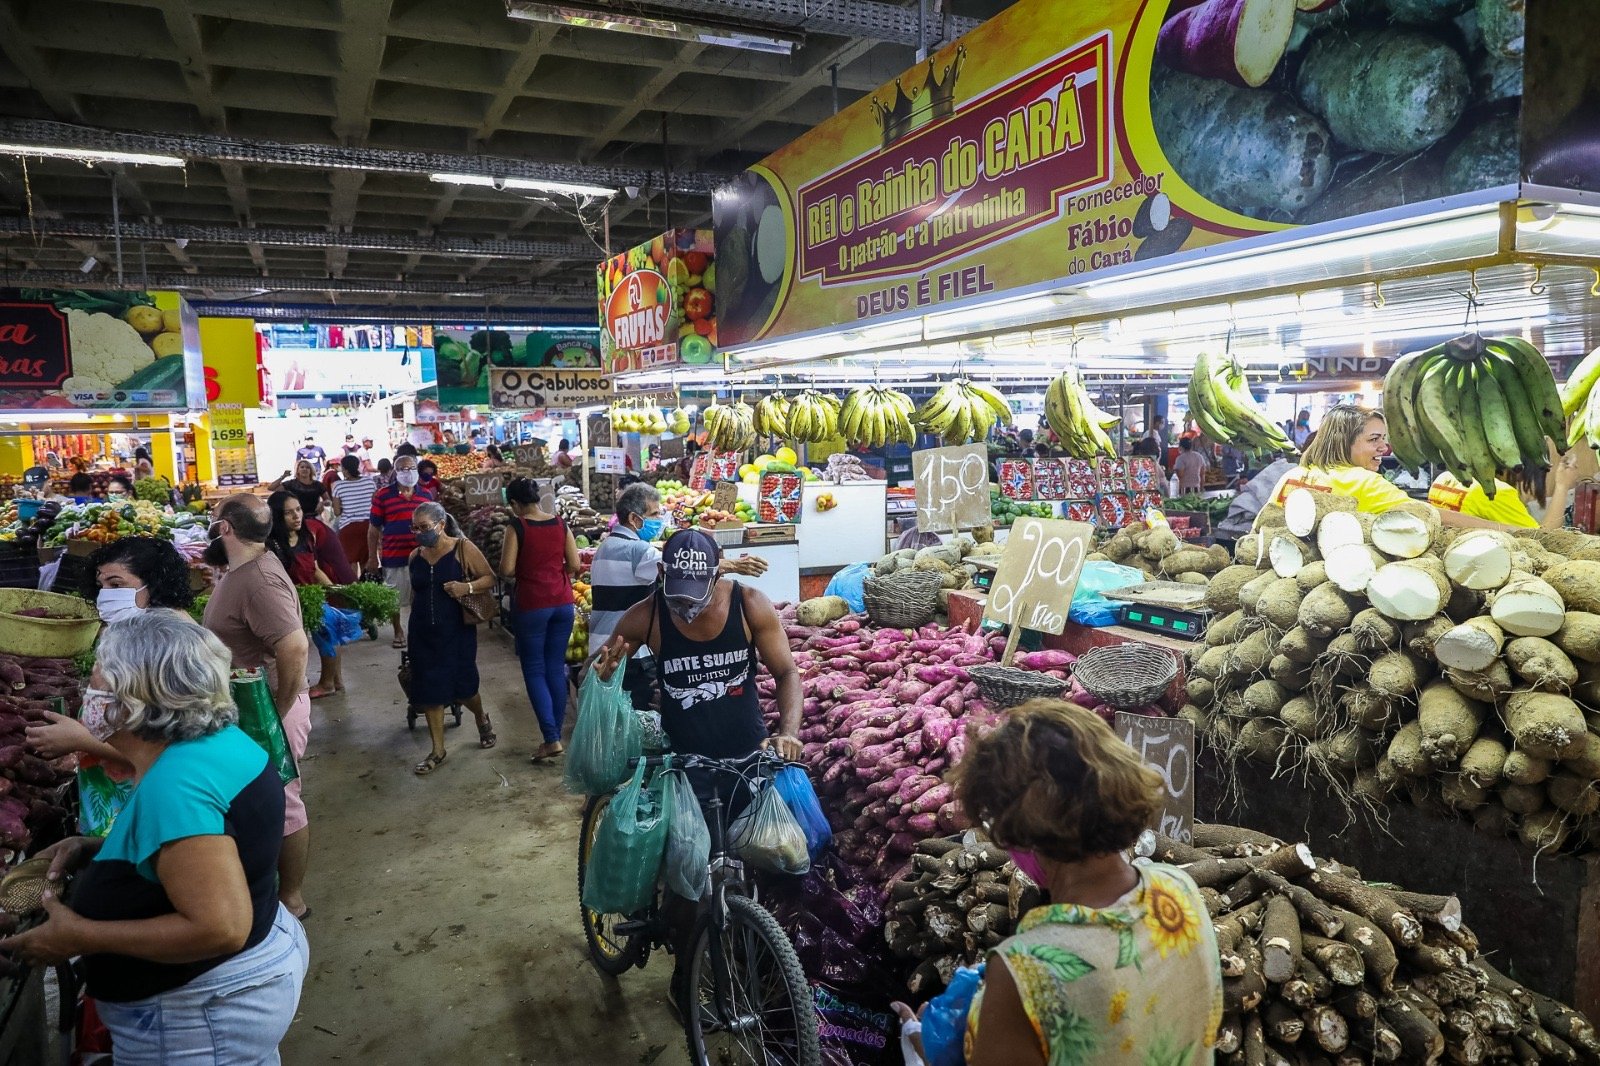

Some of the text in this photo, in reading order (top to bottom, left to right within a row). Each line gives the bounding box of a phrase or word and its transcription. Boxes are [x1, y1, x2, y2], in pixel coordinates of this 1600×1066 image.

[807, 76, 1083, 248] REI e Rainha do CARÁ
[1067, 172, 1164, 216] Fornecedor
[839, 187, 1026, 273] O patrão e a patroinha
[1067, 214, 1132, 251] Fábio
[1068, 242, 1133, 275] do Cará
[857, 264, 994, 319] DEUS É FIEL
[614, 304, 665, 350] FRUTAS
[556, 341, 593, 351] Banca da
[502, 371, 610, 390] O Cabuloso
[563, 395, 584, 403] preço
[672, 559, 707, 570] John
[674, 548, 707, 560] John
[664, 650, 749, 675] ARTE SUAVE
[688, 669, 730, 684] JIU-JITSU
[1124, 727, 1190, 798] 50
